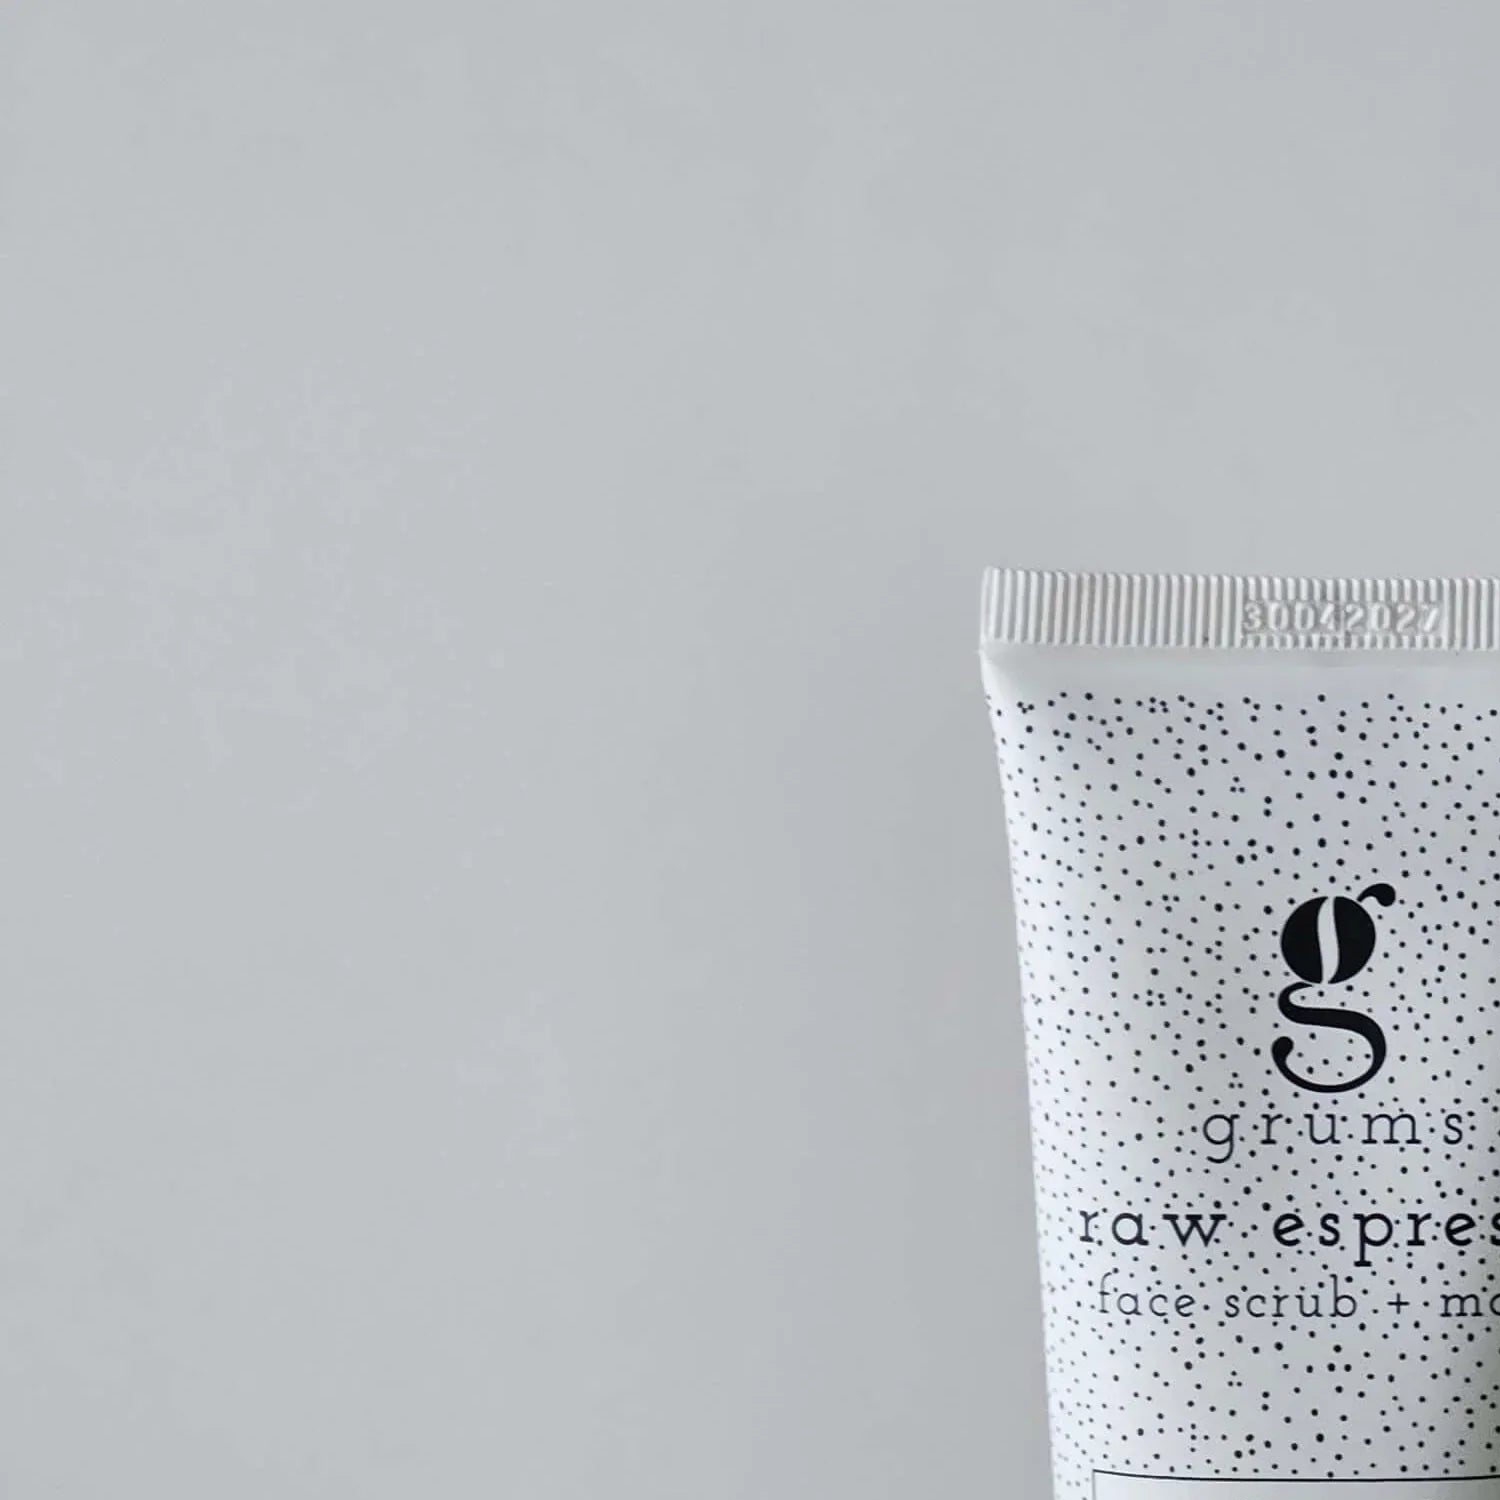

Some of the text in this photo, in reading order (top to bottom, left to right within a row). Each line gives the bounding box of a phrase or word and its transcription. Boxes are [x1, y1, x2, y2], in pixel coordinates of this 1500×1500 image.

[1272, 883, 1397, 1094] g
[1203, 1113, 1464, 1164] grums
[1079, 1209, 1228, 1247] raw
[1098, 1271, 1196, 1317] face
[1224, 1273, 1357, 1318] scrub
[1387, 1292, 1410, 1315] +
